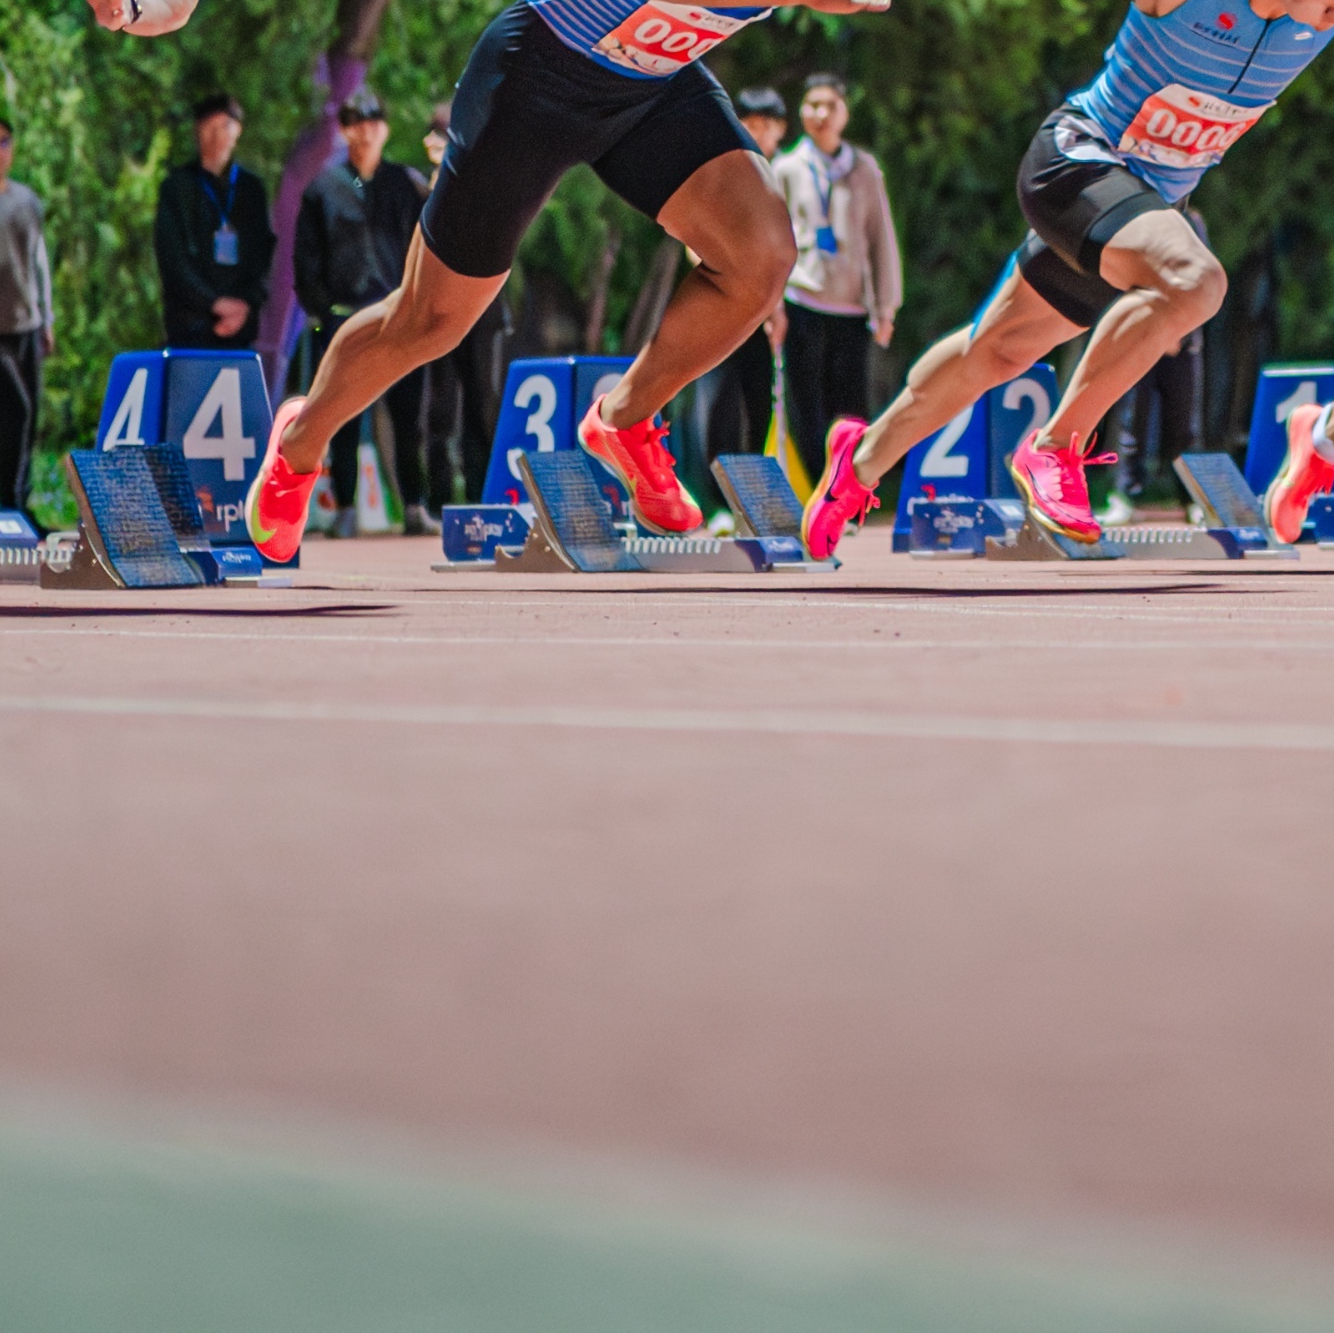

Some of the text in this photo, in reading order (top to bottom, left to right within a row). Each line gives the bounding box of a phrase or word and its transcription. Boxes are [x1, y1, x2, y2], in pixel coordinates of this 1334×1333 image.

[102, 367, 148, 451] 4
[183, 367, 256, 481] 4
[506, 374, 557, 480] 3
